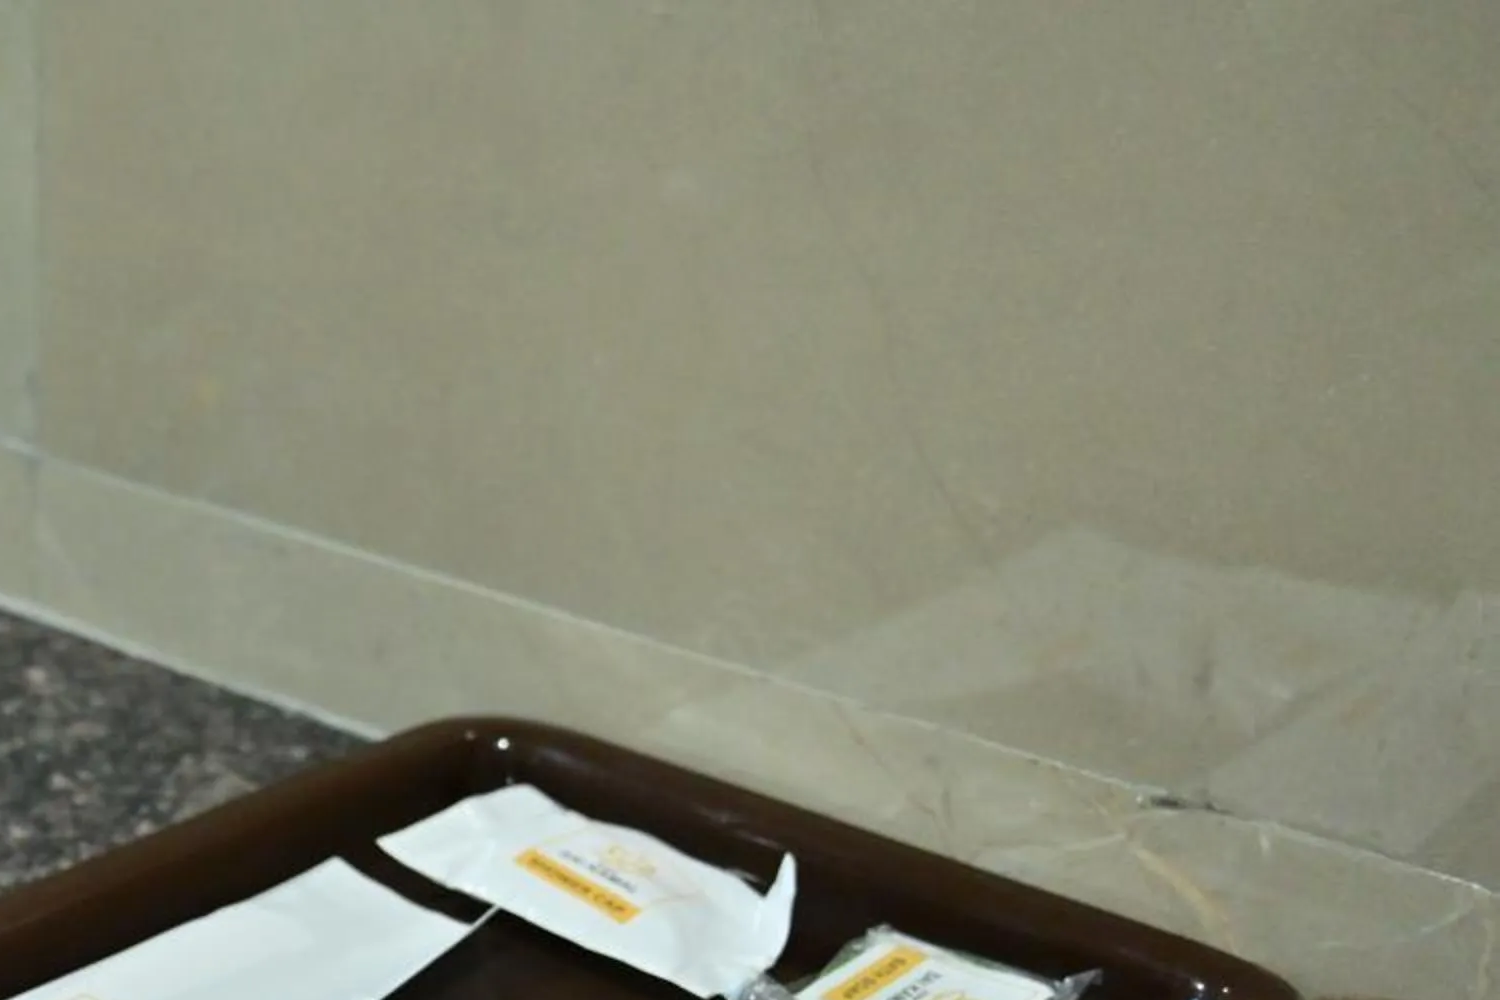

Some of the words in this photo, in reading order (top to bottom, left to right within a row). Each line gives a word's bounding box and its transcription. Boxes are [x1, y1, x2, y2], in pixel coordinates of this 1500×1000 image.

[593, 891, 628, 915] CAP
[874, 957, 907, 977] BATH
[842, 976, 877, 1000] SOAP
